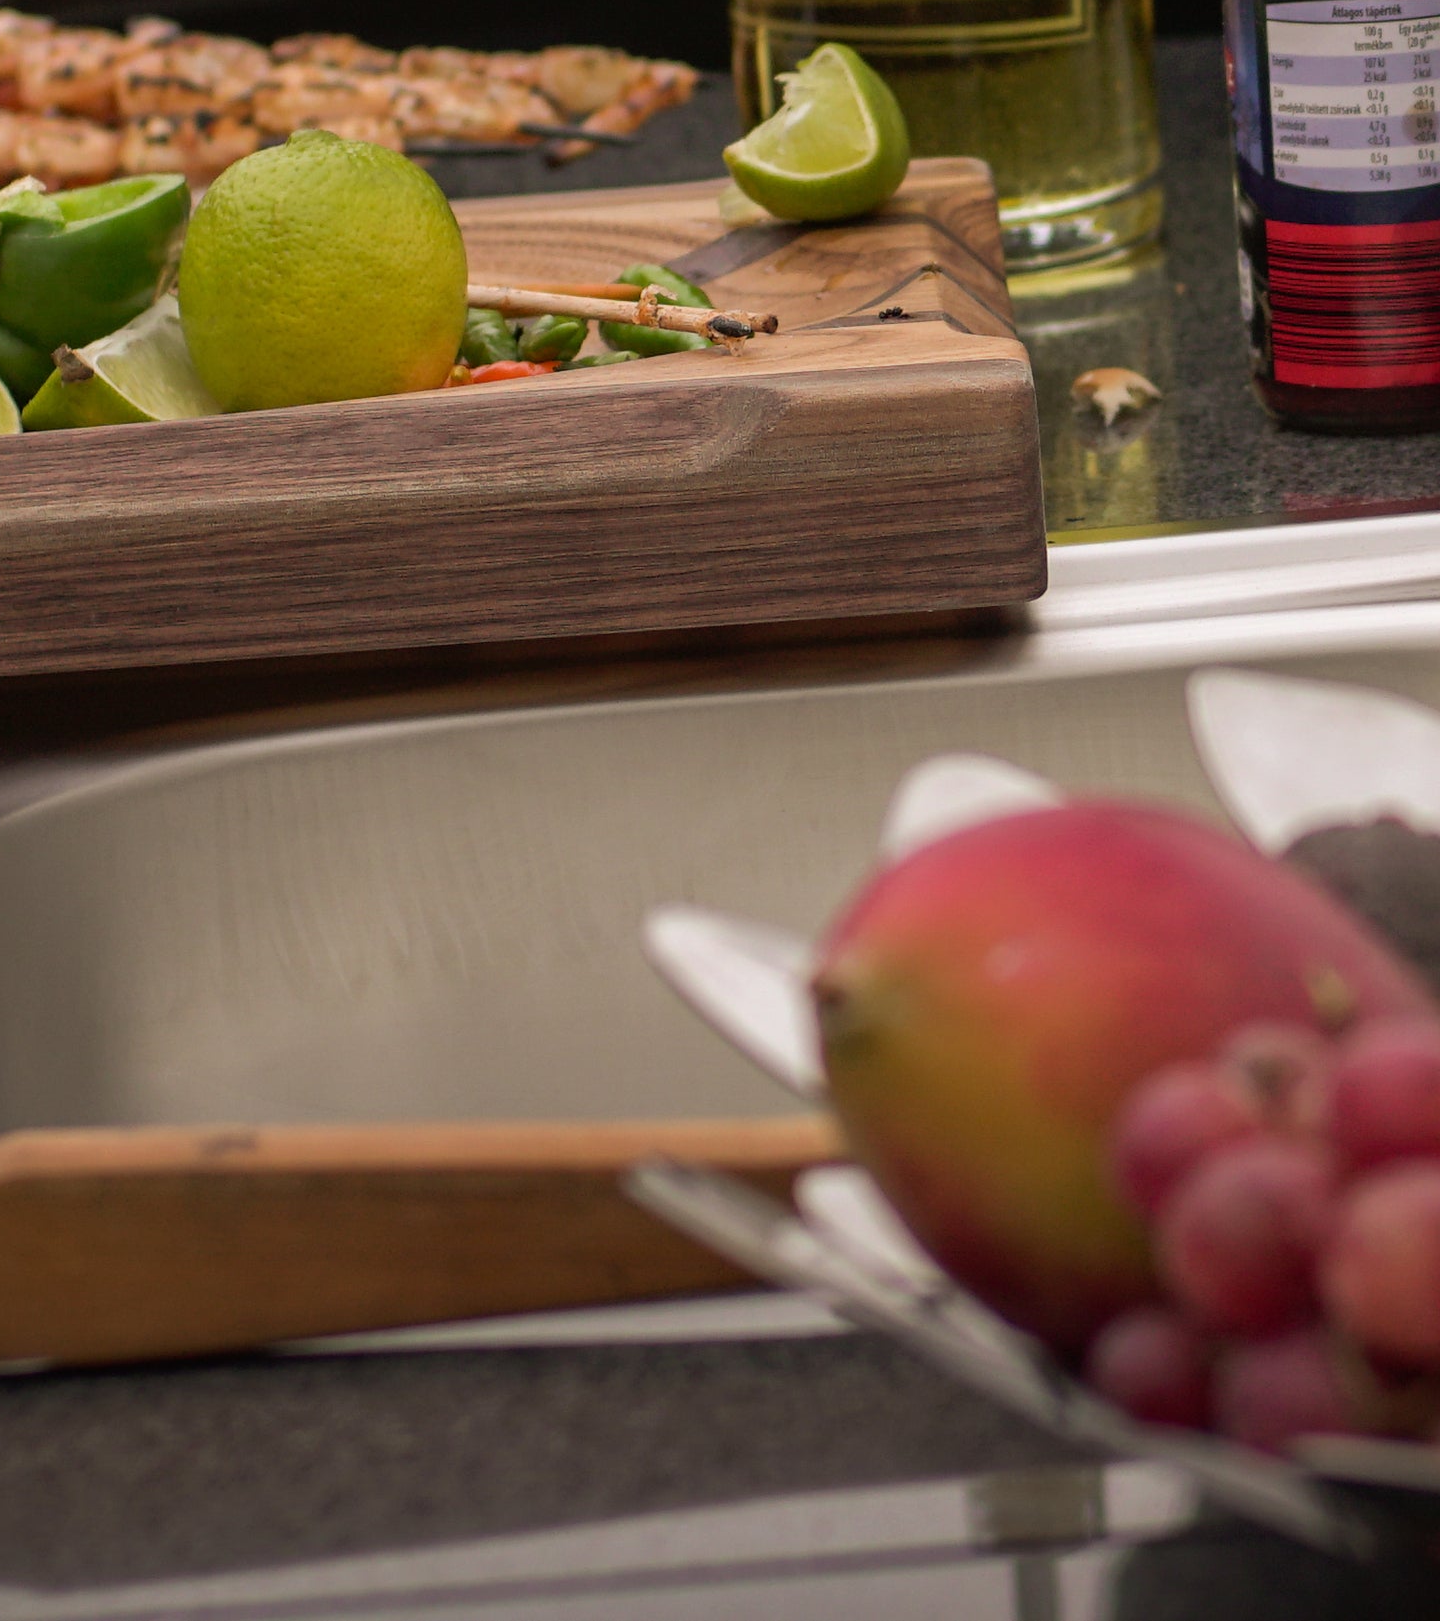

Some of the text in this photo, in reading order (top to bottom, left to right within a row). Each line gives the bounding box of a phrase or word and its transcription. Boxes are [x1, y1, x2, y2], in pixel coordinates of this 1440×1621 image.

[1331, 3, 1402, 20] Átlagos tápérték
[1364, 26, 1376, 37] 100
[1354, 39, 1393, 52] termékben
